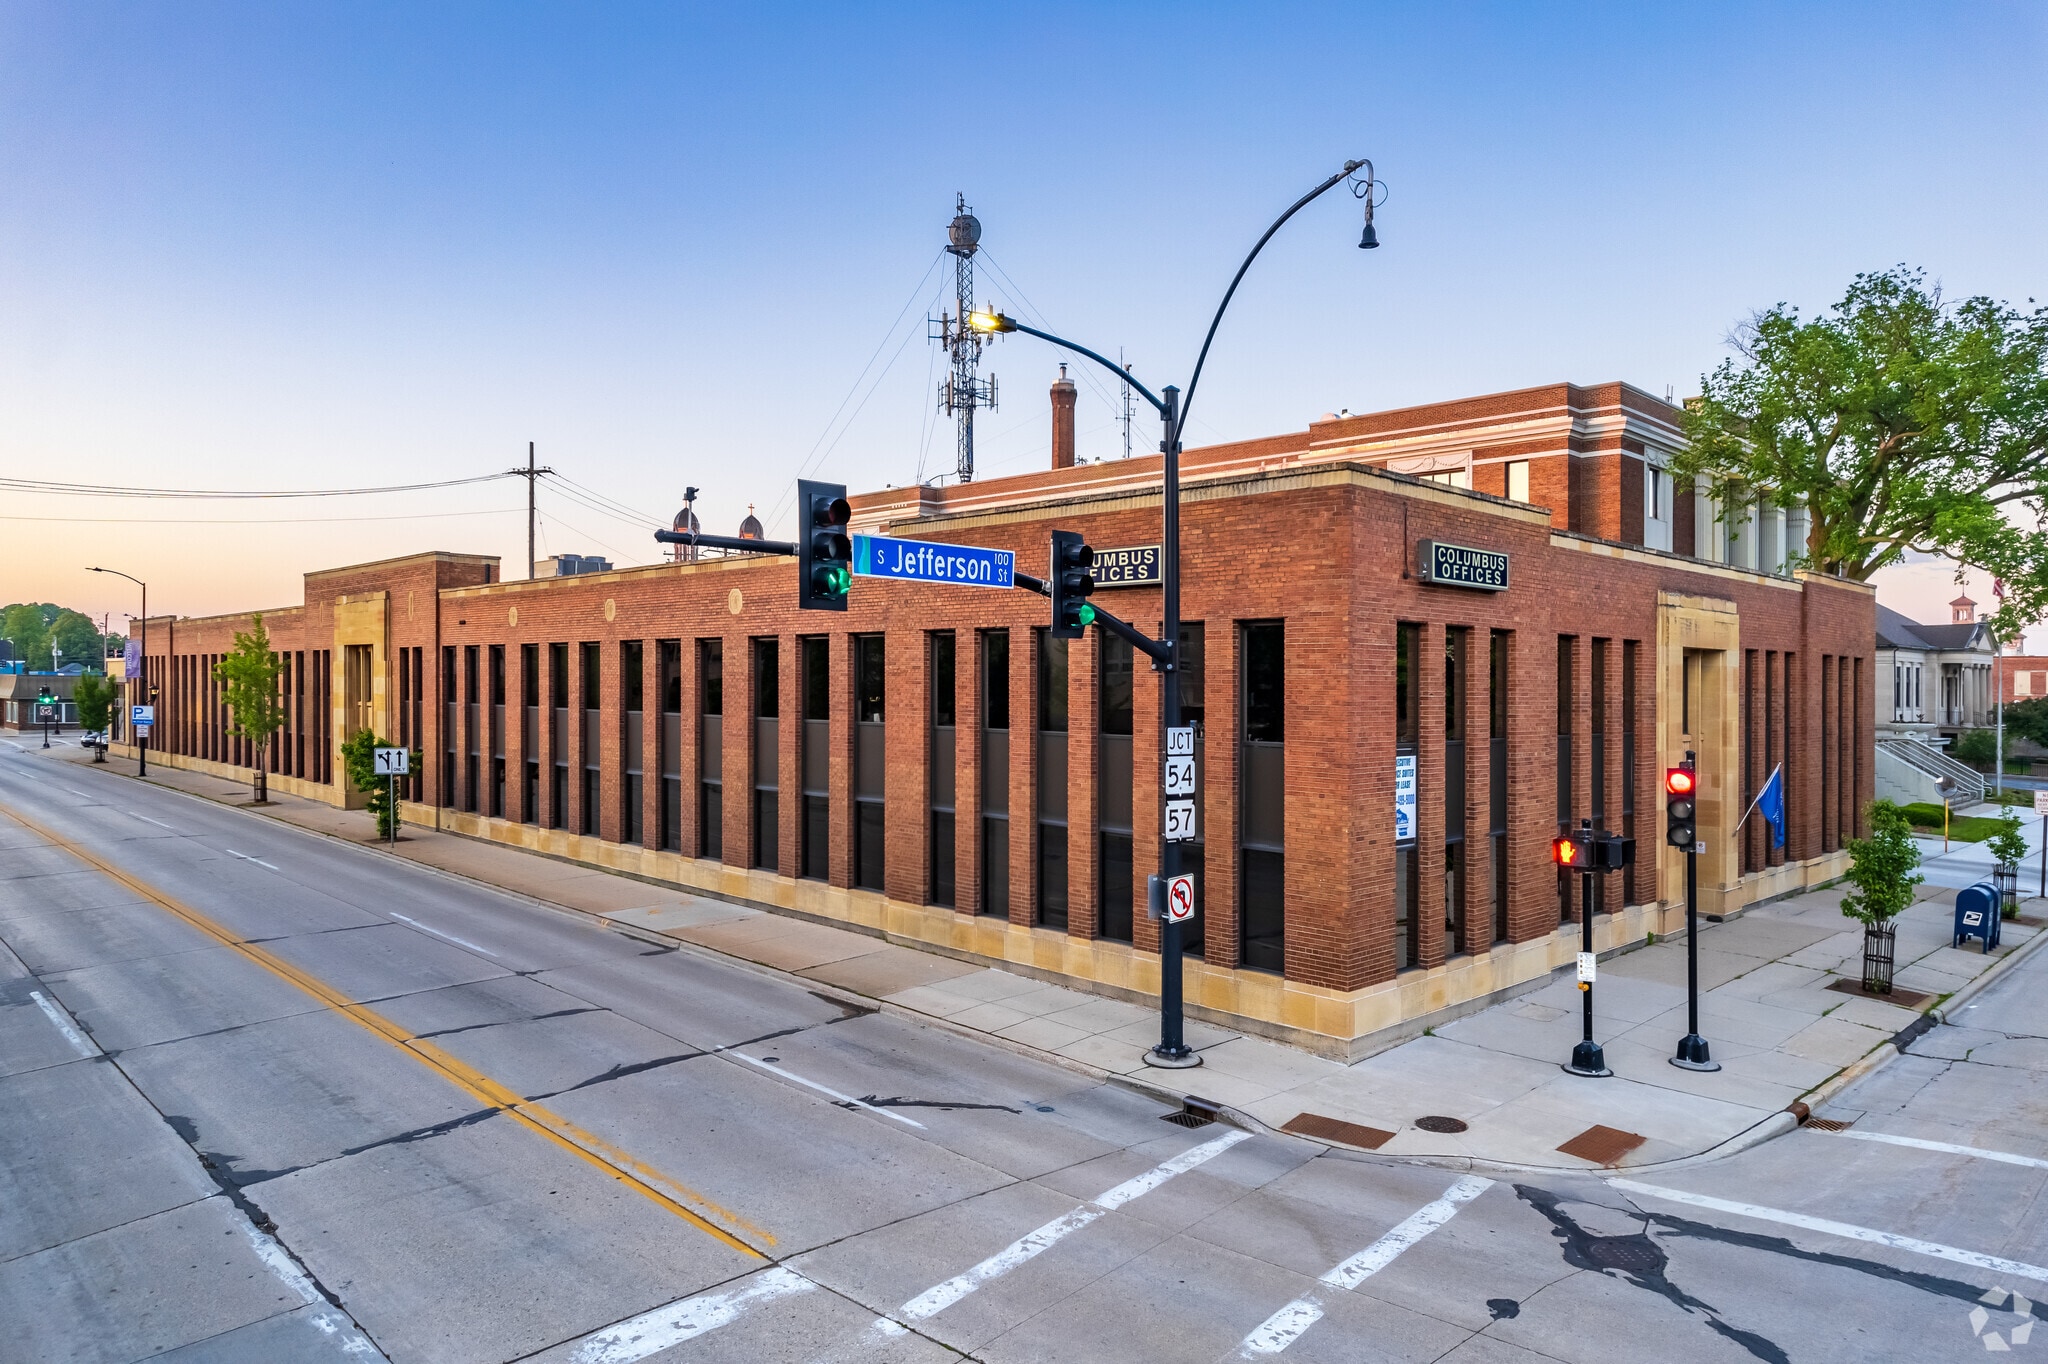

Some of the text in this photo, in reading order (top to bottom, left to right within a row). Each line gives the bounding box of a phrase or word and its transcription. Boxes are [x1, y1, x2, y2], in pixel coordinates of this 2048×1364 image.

[877, 544, 991, 581] S Jefferson
[994, 553, 1009, 566] 100
[1092, 549, 1154, 568] UMBUS
[1438, 547, 1505, 571] COLUMBUS
[997, 568, 1008, 583] St
[1089, 564, 1148, 581] FICES
[1442, 563, 1501, 585] OFFICES
[133, 707, 144, 719] P
[1169, 732, 1192, 750] JCT
[1168, 764, 1193, 788] 54
[1168, 808, 1193, 833] 57
